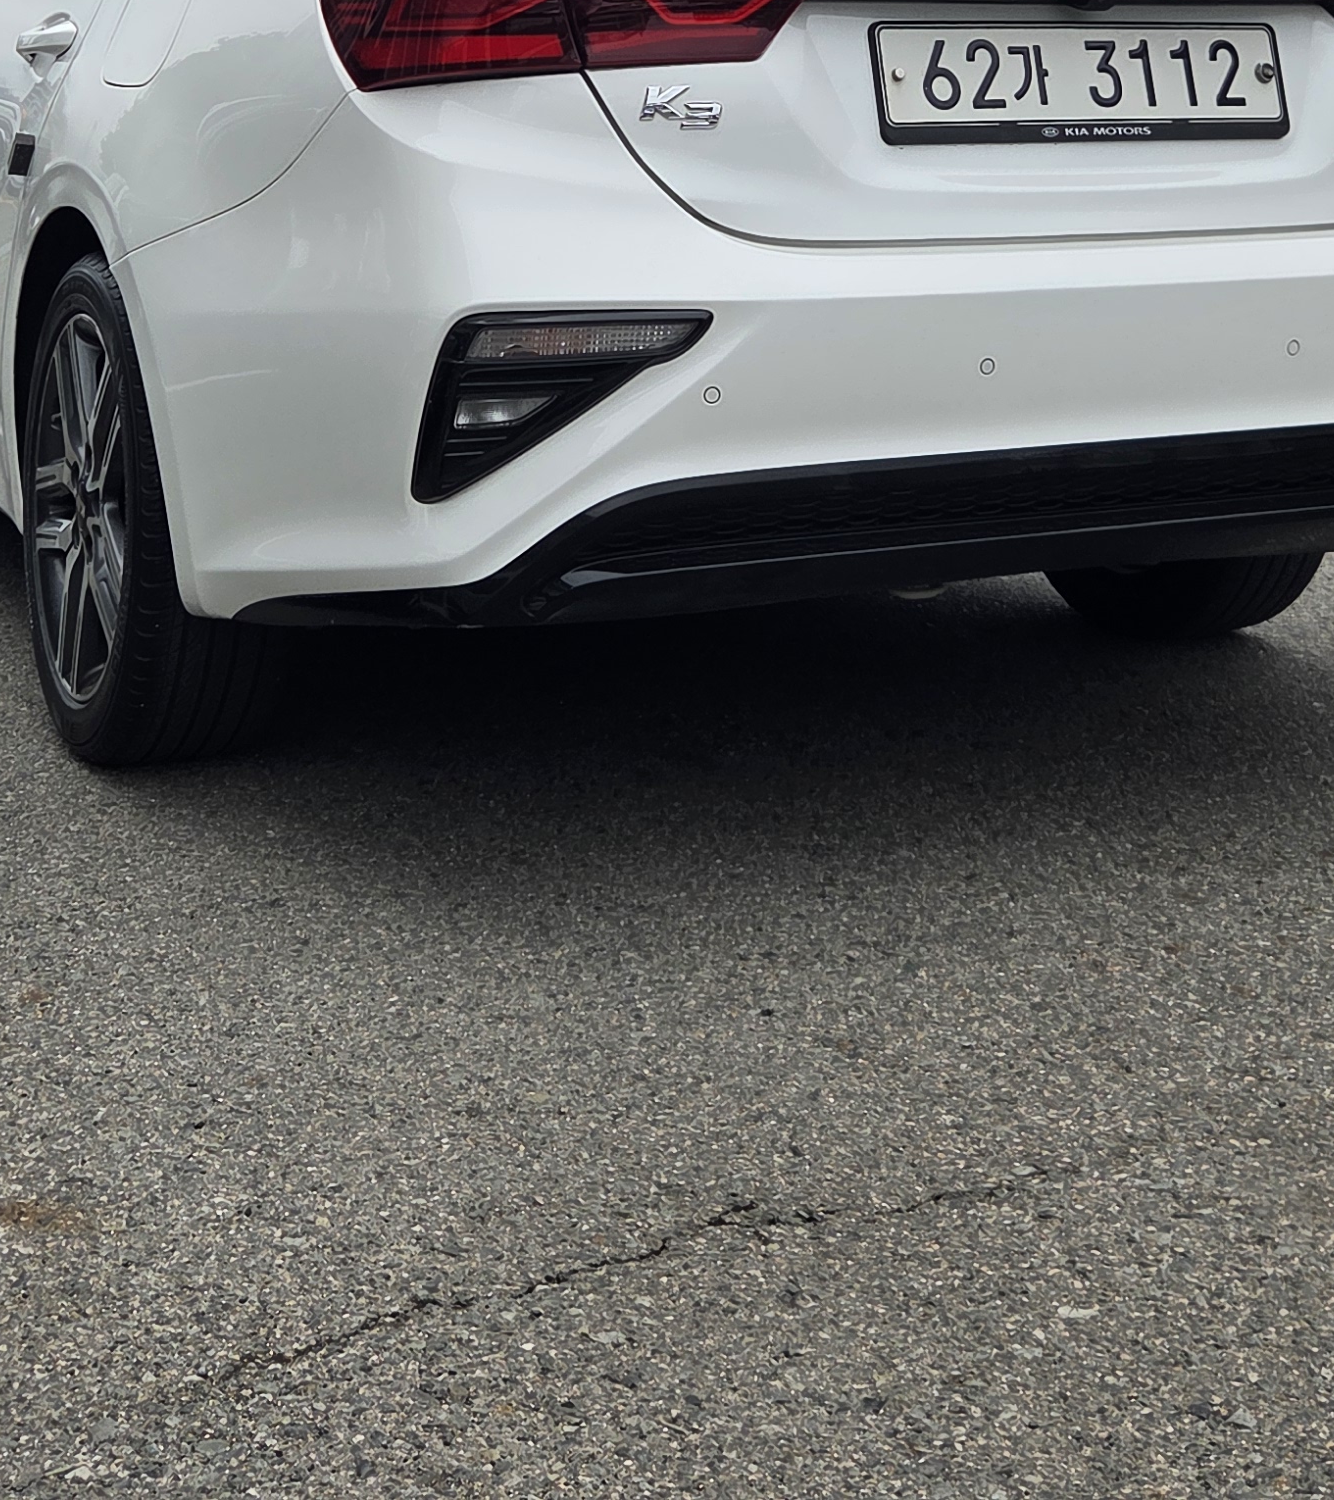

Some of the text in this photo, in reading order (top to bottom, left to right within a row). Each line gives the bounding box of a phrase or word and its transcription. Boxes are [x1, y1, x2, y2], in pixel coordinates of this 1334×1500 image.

[922, 39, 1247, 111] 62가 3112
[639, 84, 723, 131] K3
[1064, 126, 1152, 136] KIA MOTORS
